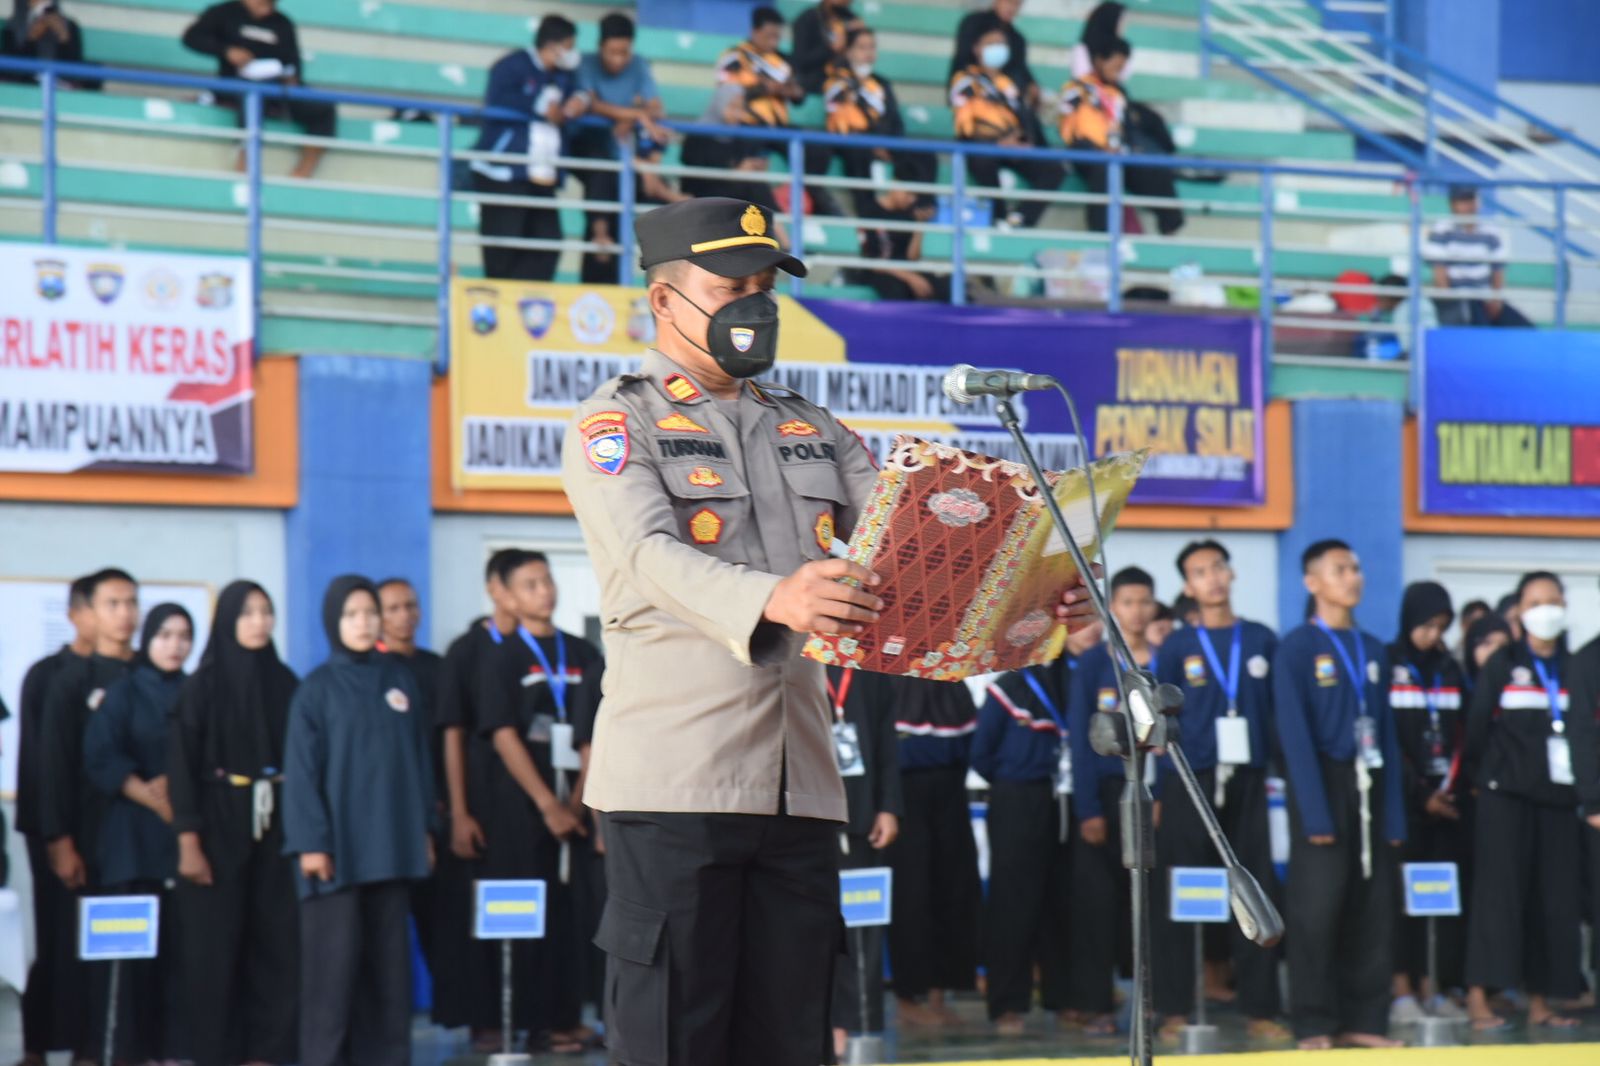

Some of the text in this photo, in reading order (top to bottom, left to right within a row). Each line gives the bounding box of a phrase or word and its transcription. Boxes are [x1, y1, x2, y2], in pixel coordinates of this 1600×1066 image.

[0, 317, 228, 377] RLATIH KERAS
[826, 368, 917, 416] MENJADI
